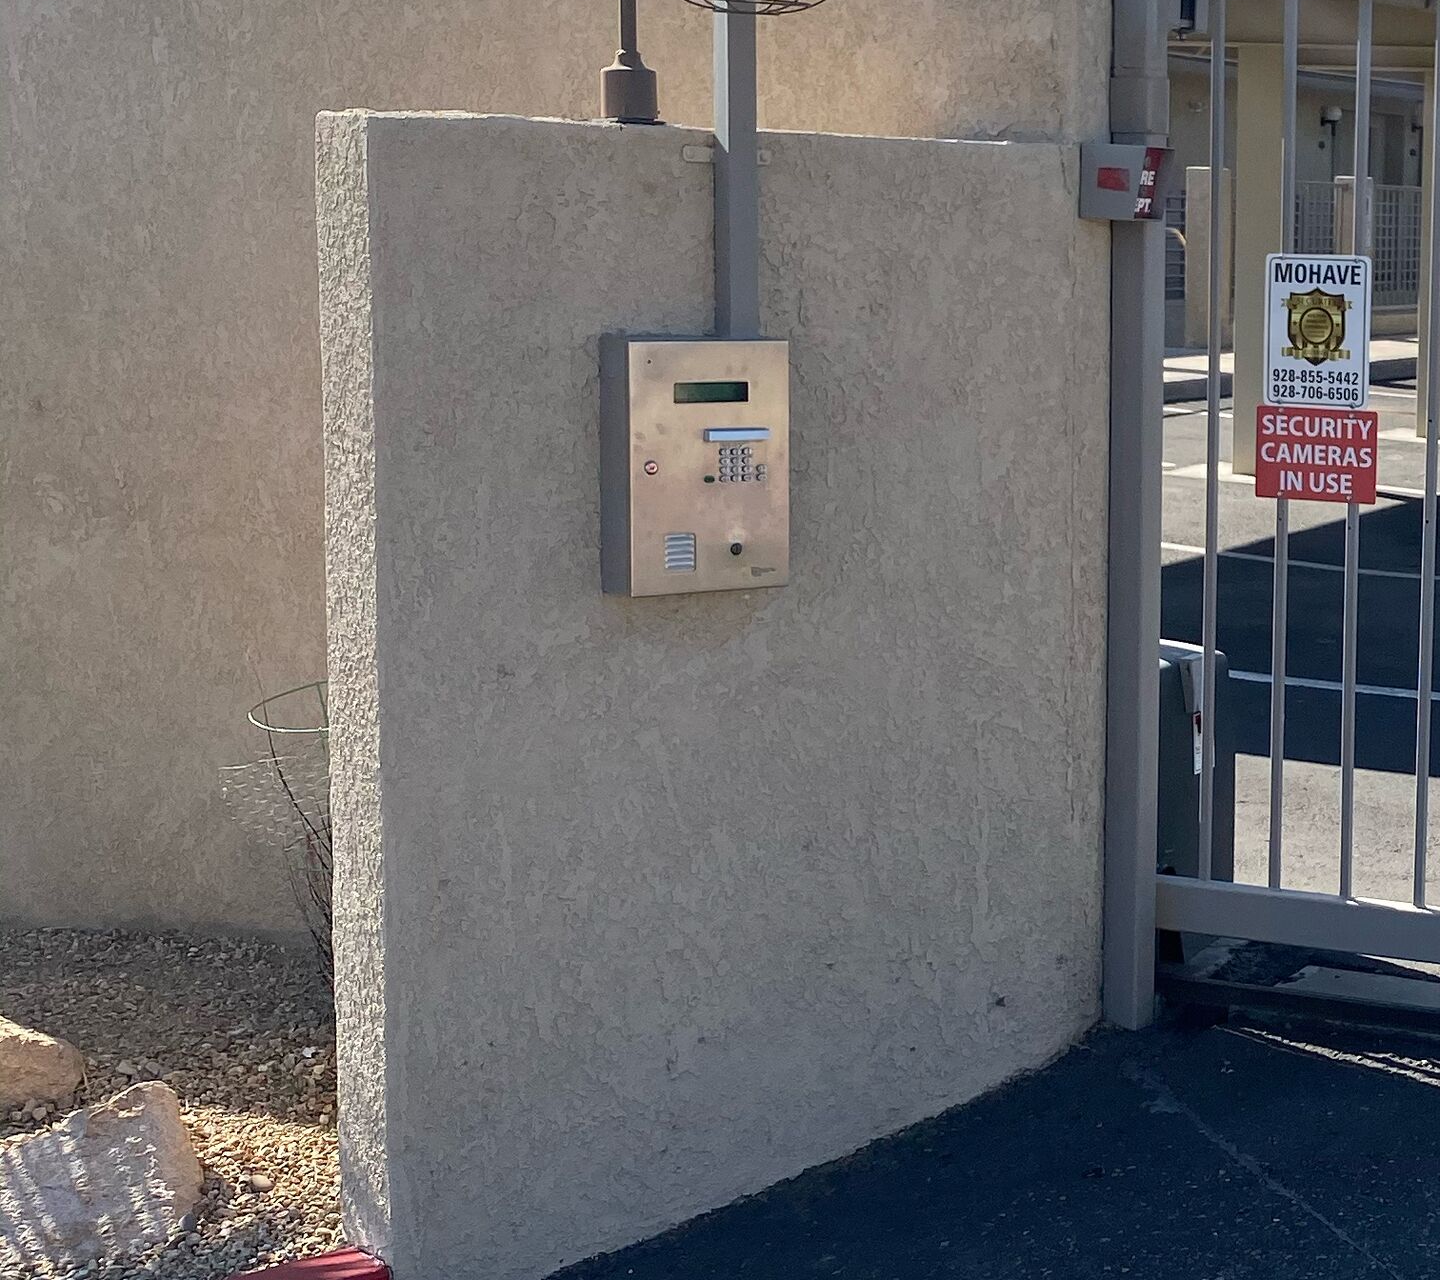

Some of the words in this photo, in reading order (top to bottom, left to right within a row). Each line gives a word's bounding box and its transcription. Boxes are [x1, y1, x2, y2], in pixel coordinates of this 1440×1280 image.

[1139, 170, 1156, 186] RE
[1274, 262, 1361, 285] MOHAVE
[1272, 369, 1359, 386] 928-855-5442
[1272, 384, 1359, 402] 928-706-6506
[1261, 414, 1372, 440] SECURITY
[1260, 442, 1372, 468] CAMERAS
[1279, 470, 1303, 491] IN
[1309, 472, 1353, 495] USE
